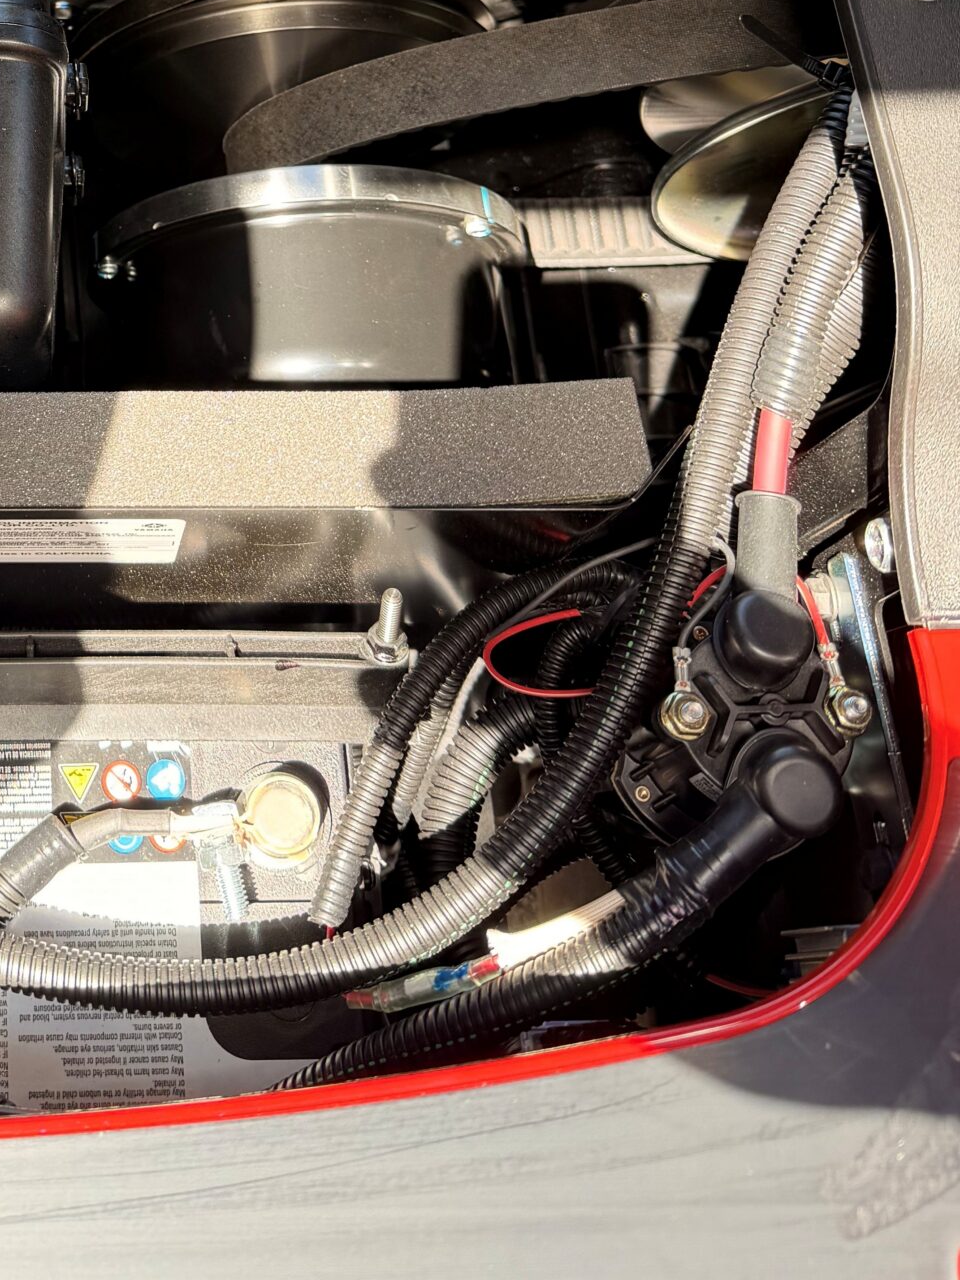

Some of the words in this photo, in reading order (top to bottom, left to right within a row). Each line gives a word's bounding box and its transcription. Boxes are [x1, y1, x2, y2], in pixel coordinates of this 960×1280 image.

[23, 931, 39, 939] been
[40, 930, 54, 938] have
[55, 929, 91, 938] precautions
[92, 928, 110, 938] safety
[111, 929, 119, 937] all
[120, 929, 133, 937] until
[135, 928, 155, 937] handle
[156, 928, 166, 936] not
[167, 928, 177, 936] Do
[52, 1045, 79, 1054] damage.
[80, 1043, 91, 1052] eye
[92, 1044, 115, 1053] serious
[116, 1043, 145, 1053] irritation,
[146, 1044, 160, 1053] skin
[160, 1044, 183, 1052] Causes
[61, 1057, 85, 1066] inhaled.
[86, 1057, 94, 1065] or
[95, 1055, 122, 1065] ingested
[123, 1056, 128, 1065] if
[129, 1056, 150, 1064] cancer
[151, 1055, 169, 1064] cause
[171, 1055, 183, 1064] May
[65, 1069, 91, 1078] children.
[92, 1068, 124, 1077] breast-fed
[125, 1068, 132, 1076] to
[133, 1068, 150, 1076] harm
[151, 1068, 170, 1076] cause
[171, 1067, 185, 1076] May
